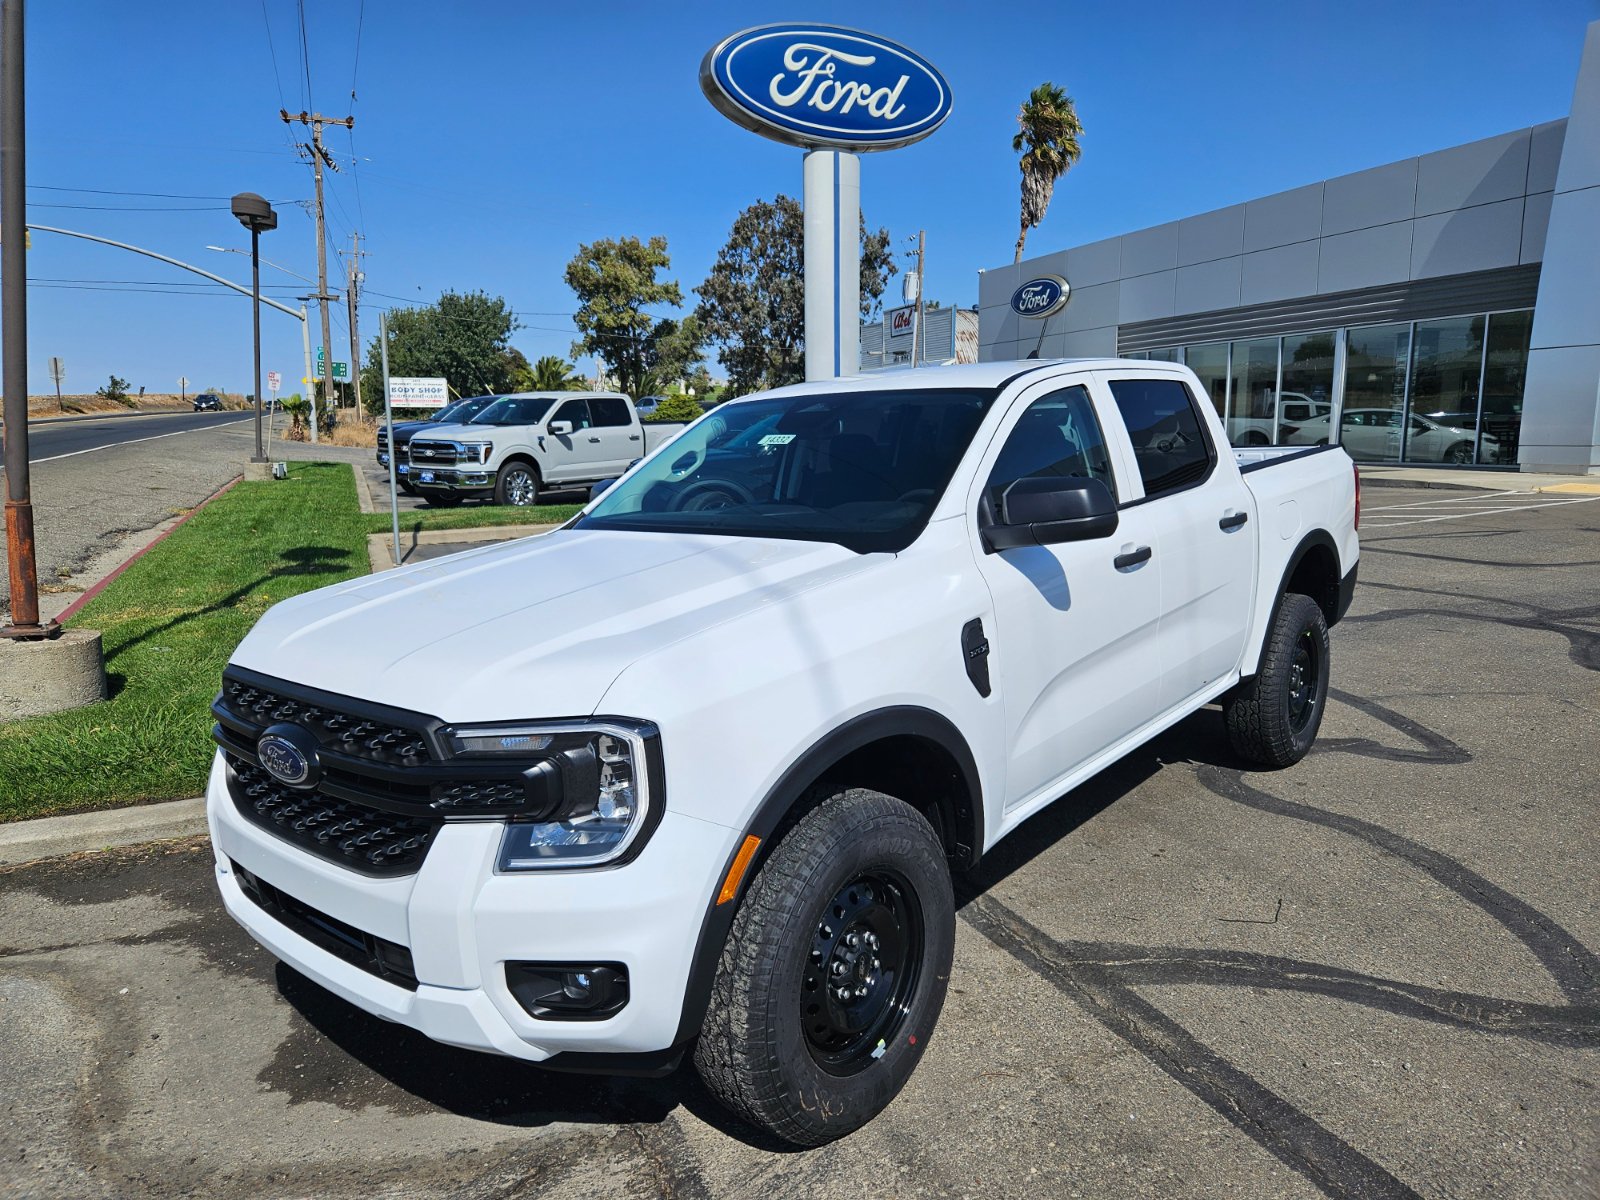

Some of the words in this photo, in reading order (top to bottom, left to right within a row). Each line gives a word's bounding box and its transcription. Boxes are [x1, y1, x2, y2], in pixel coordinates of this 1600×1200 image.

[769, 42, 910, 120] Ford
[1019, 285, 1050, 311] Ford
[265, 745, 293, 775] Ford
